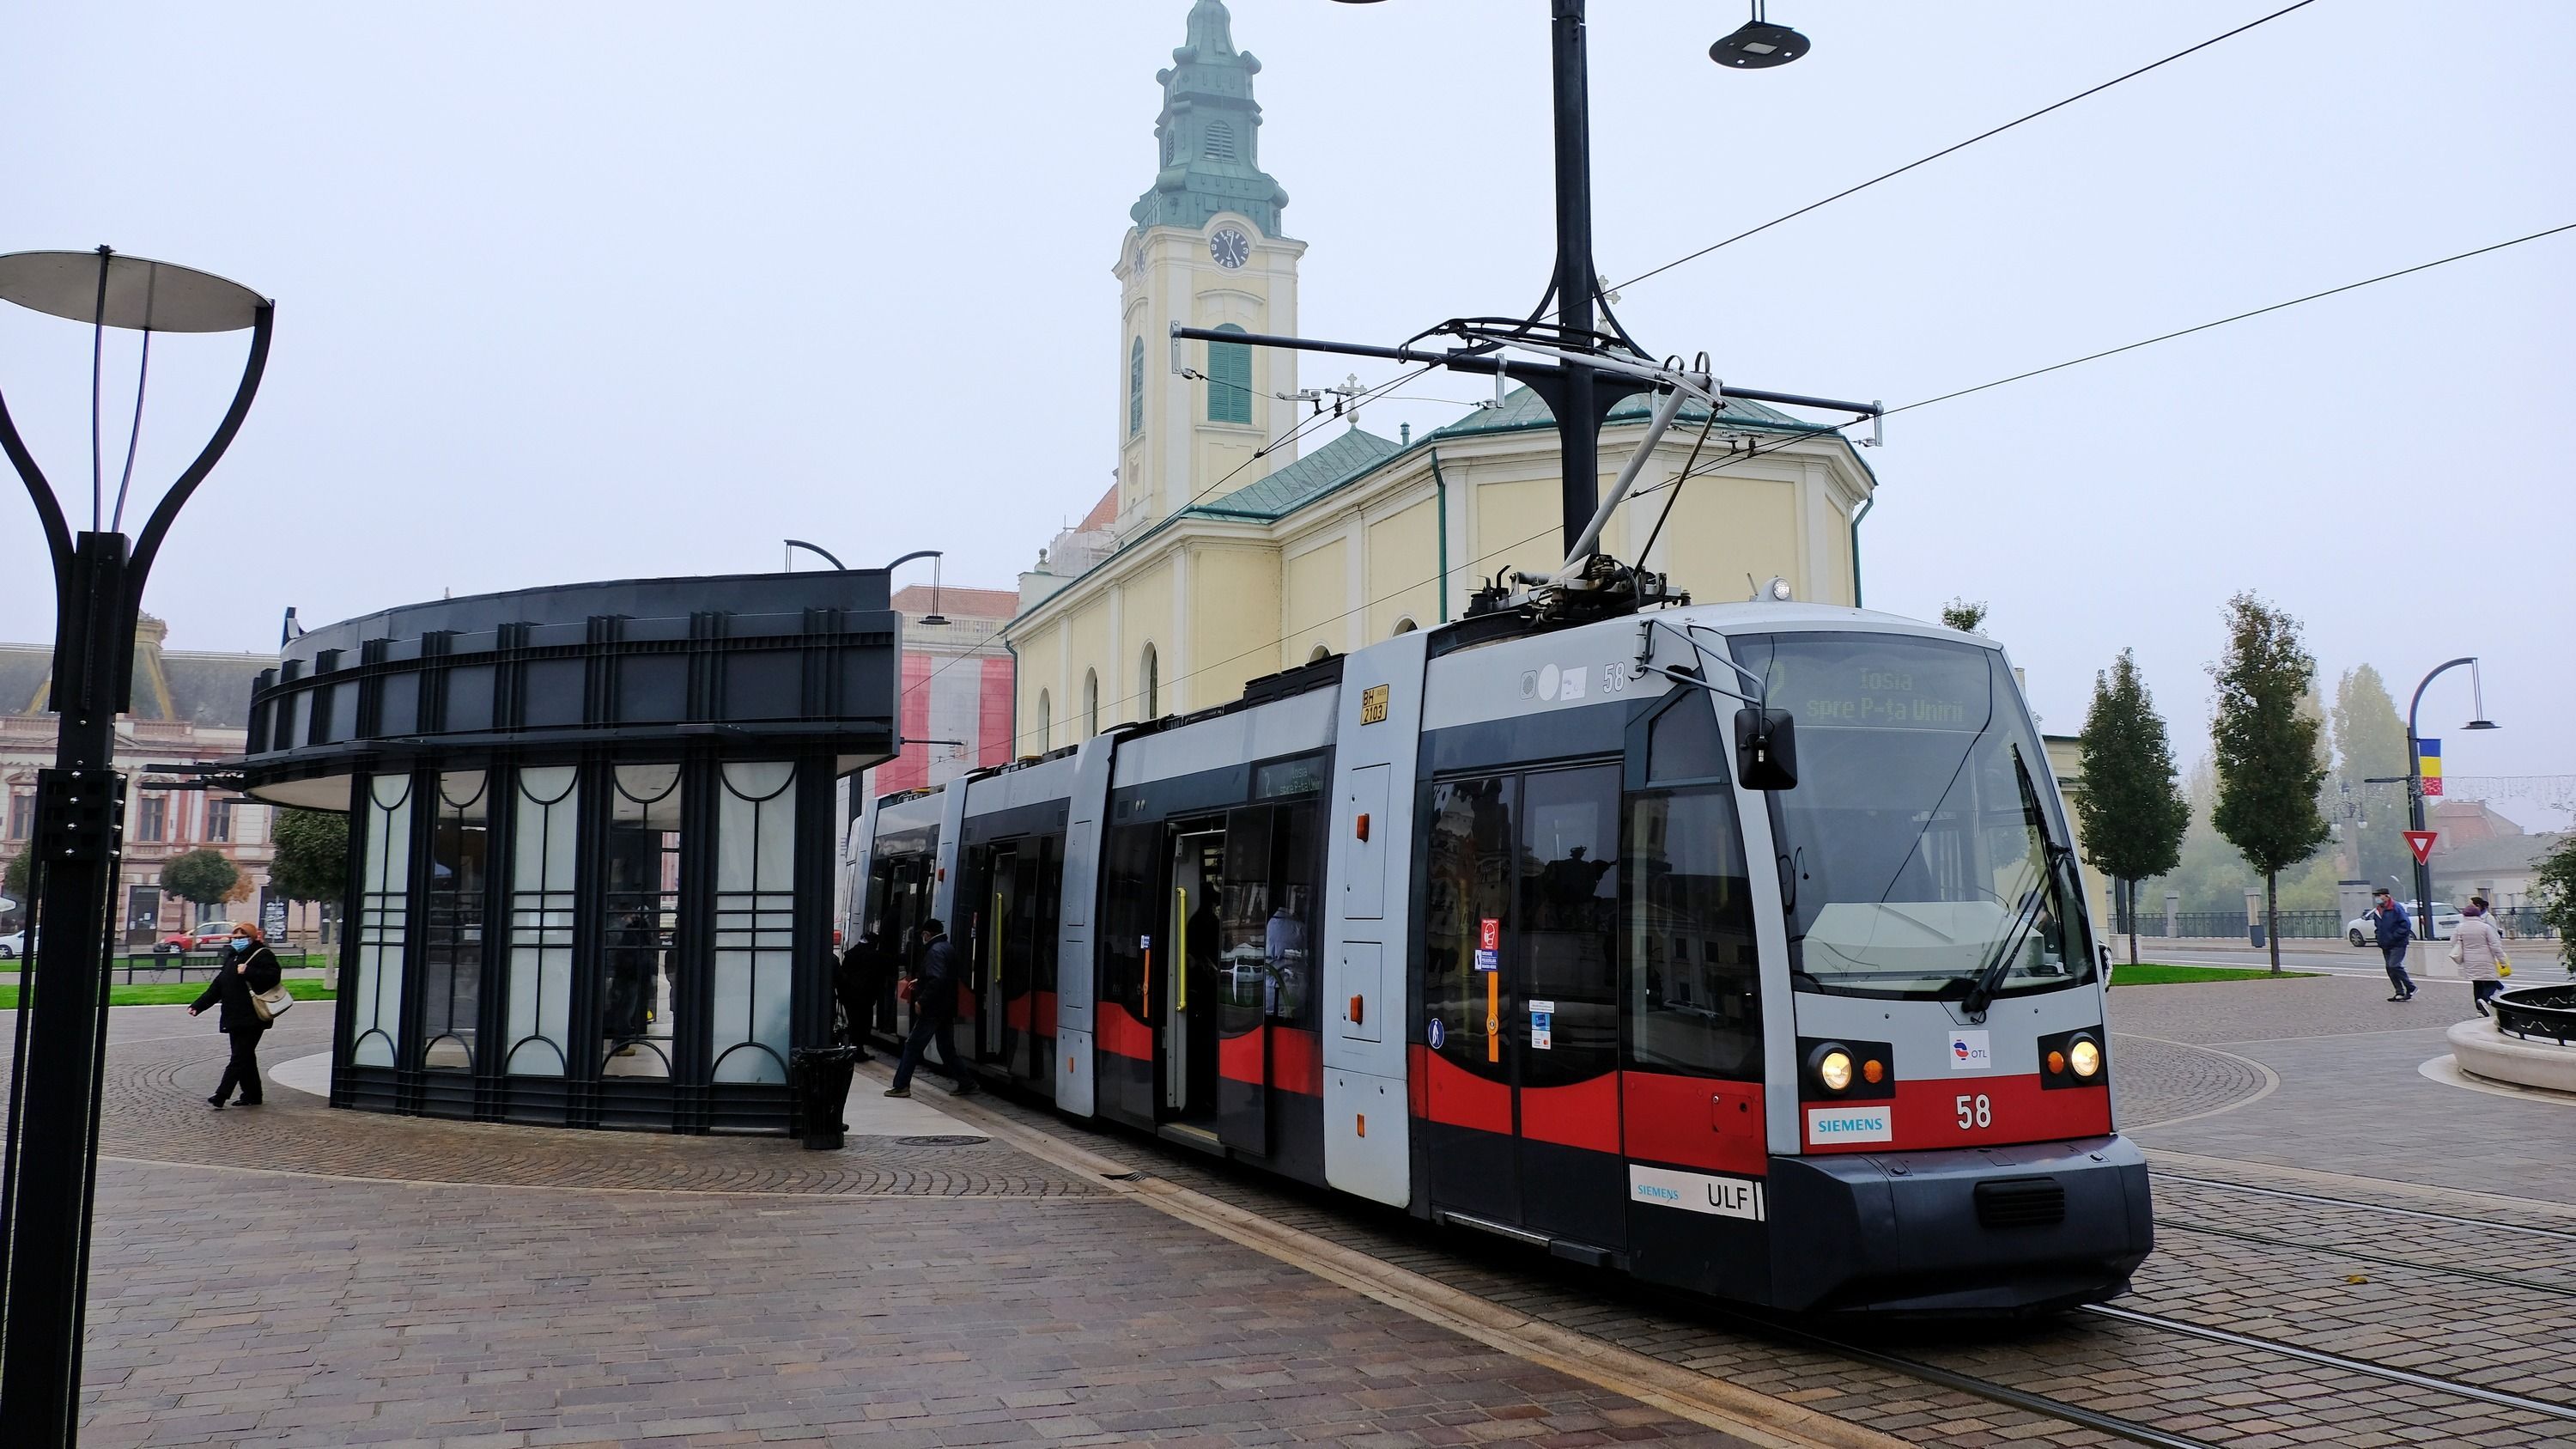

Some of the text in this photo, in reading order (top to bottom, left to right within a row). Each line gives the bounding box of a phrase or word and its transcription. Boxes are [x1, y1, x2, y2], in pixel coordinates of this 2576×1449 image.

[1602, 661, 1625, 694] 58
[1364, 689, 1375, 706] BH
[1364, 704, 1383, 723] 2103
[1807, 698, 1856, 720] spre
[1913, 698, 1965, 722] Unirii
[1971, 1050, 1988, 1059] OTL
[1955, 1093, 1992, 1130] 58
[1818, 1117, 1883, 1133] SIEMENS
[1637, 1182, 1748, 1210] SIEMENS ULF
